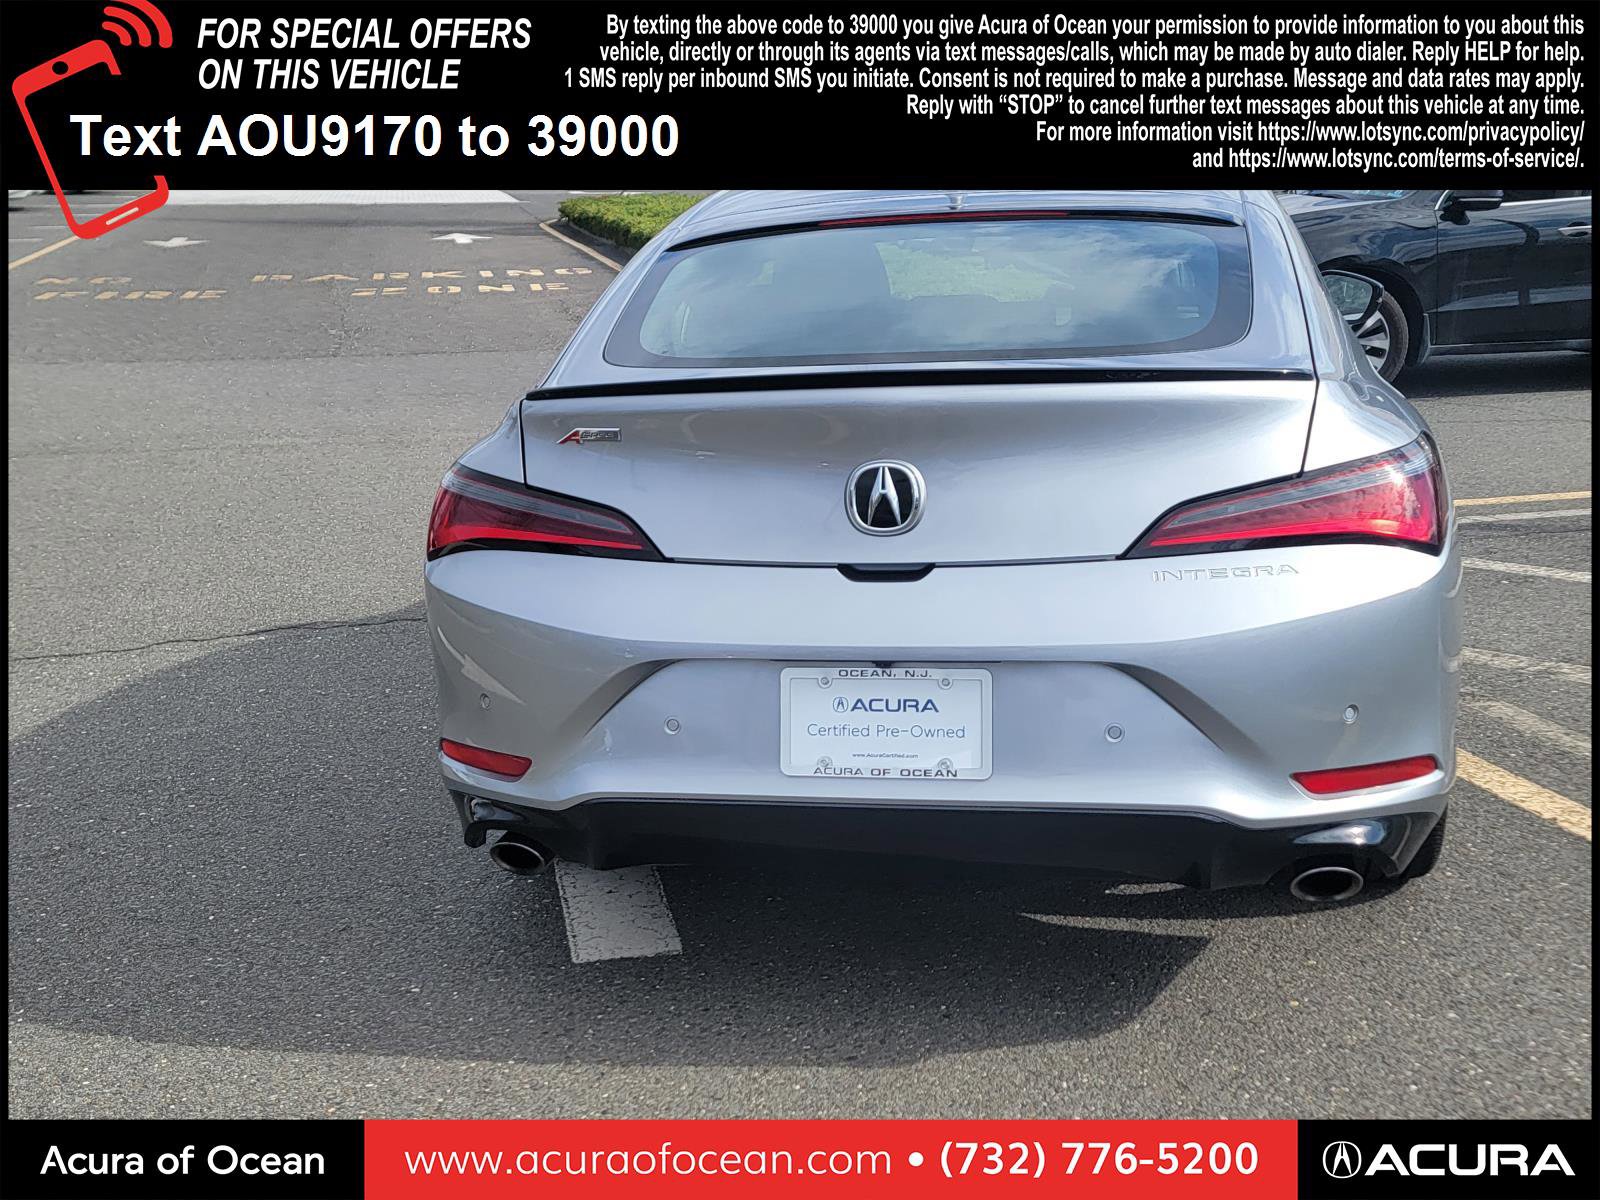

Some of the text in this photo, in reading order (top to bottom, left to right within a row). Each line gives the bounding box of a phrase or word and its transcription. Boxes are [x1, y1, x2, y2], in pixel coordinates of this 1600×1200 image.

[1152, 564, 1299, 583] INTEGRA
[838, 669, 932, 678] OCEAN, N.J.
[850, 698, 939, 713] ACURA
[807, 723, 965, 739] Certified Pre-Owned
[813, 767, 958, 778] ACURA OF OCEAN
